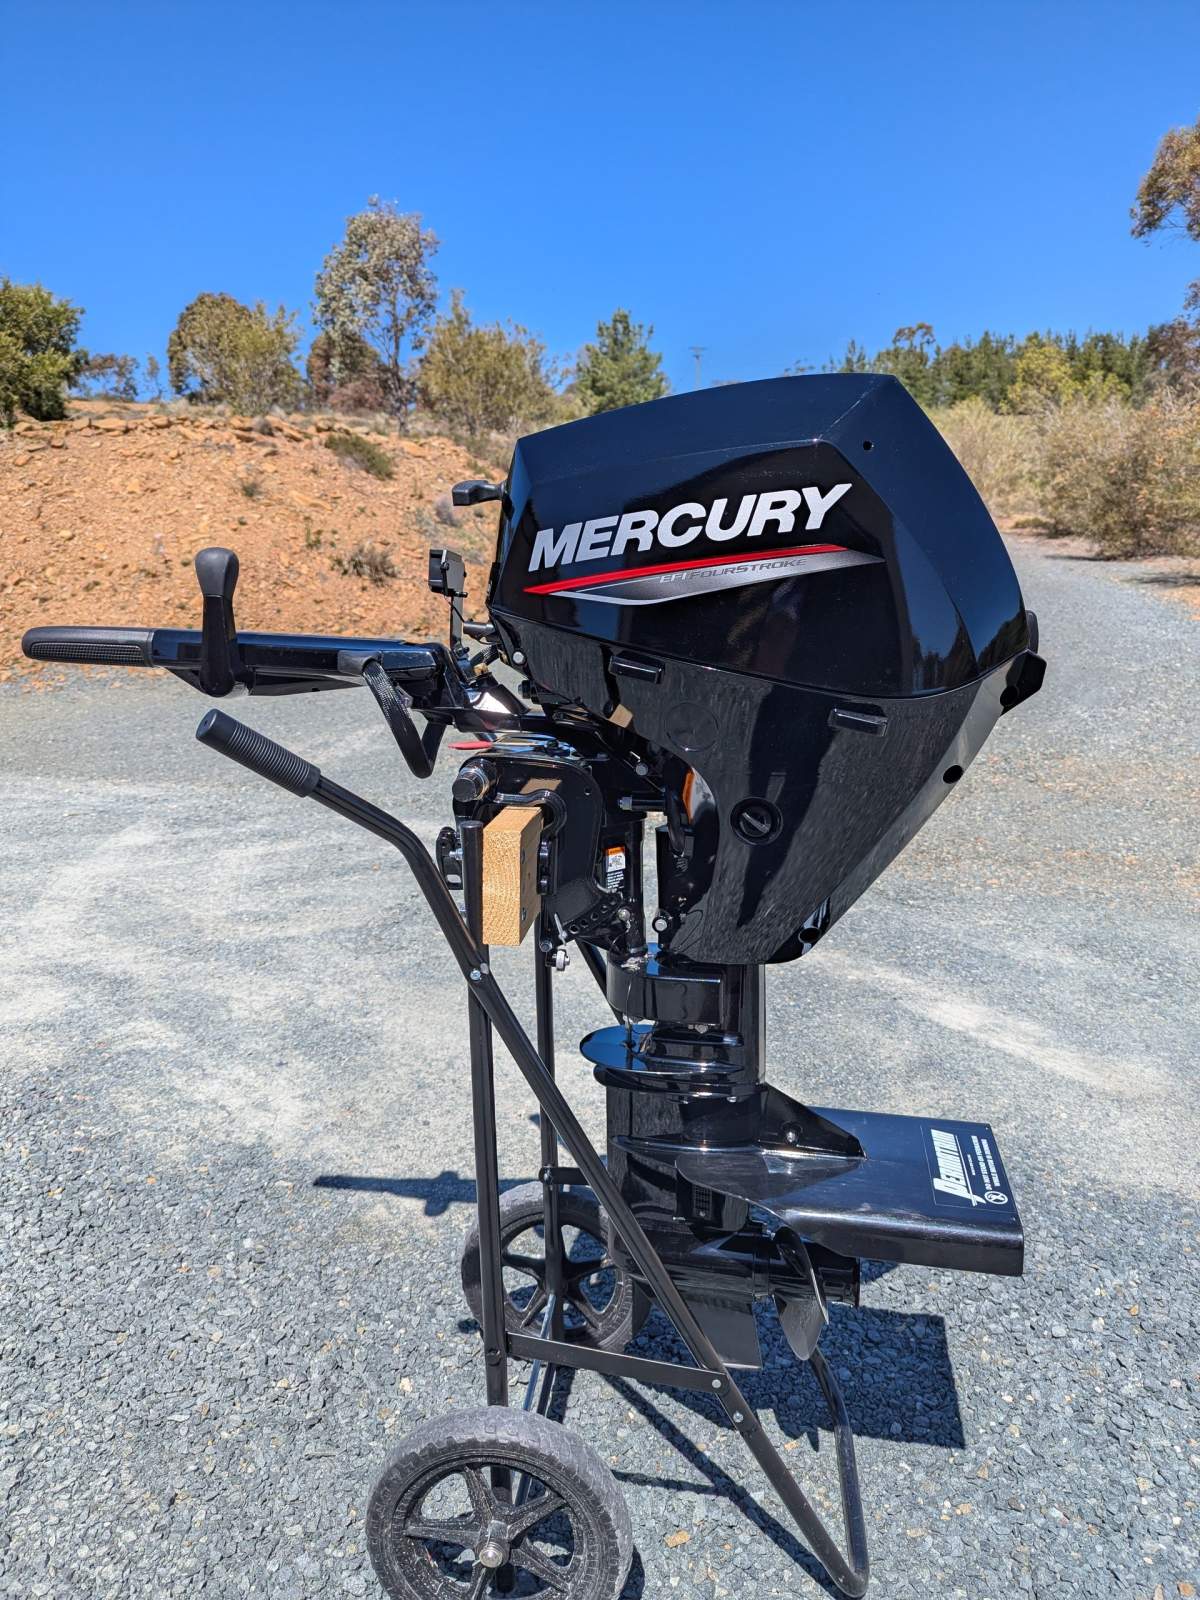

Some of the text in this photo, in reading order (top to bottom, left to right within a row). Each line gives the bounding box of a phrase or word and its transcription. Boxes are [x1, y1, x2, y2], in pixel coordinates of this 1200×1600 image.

[528, 483, 853, 572] MERCURY
[659, 559, 806, 583] EFI FOURSTROKE
